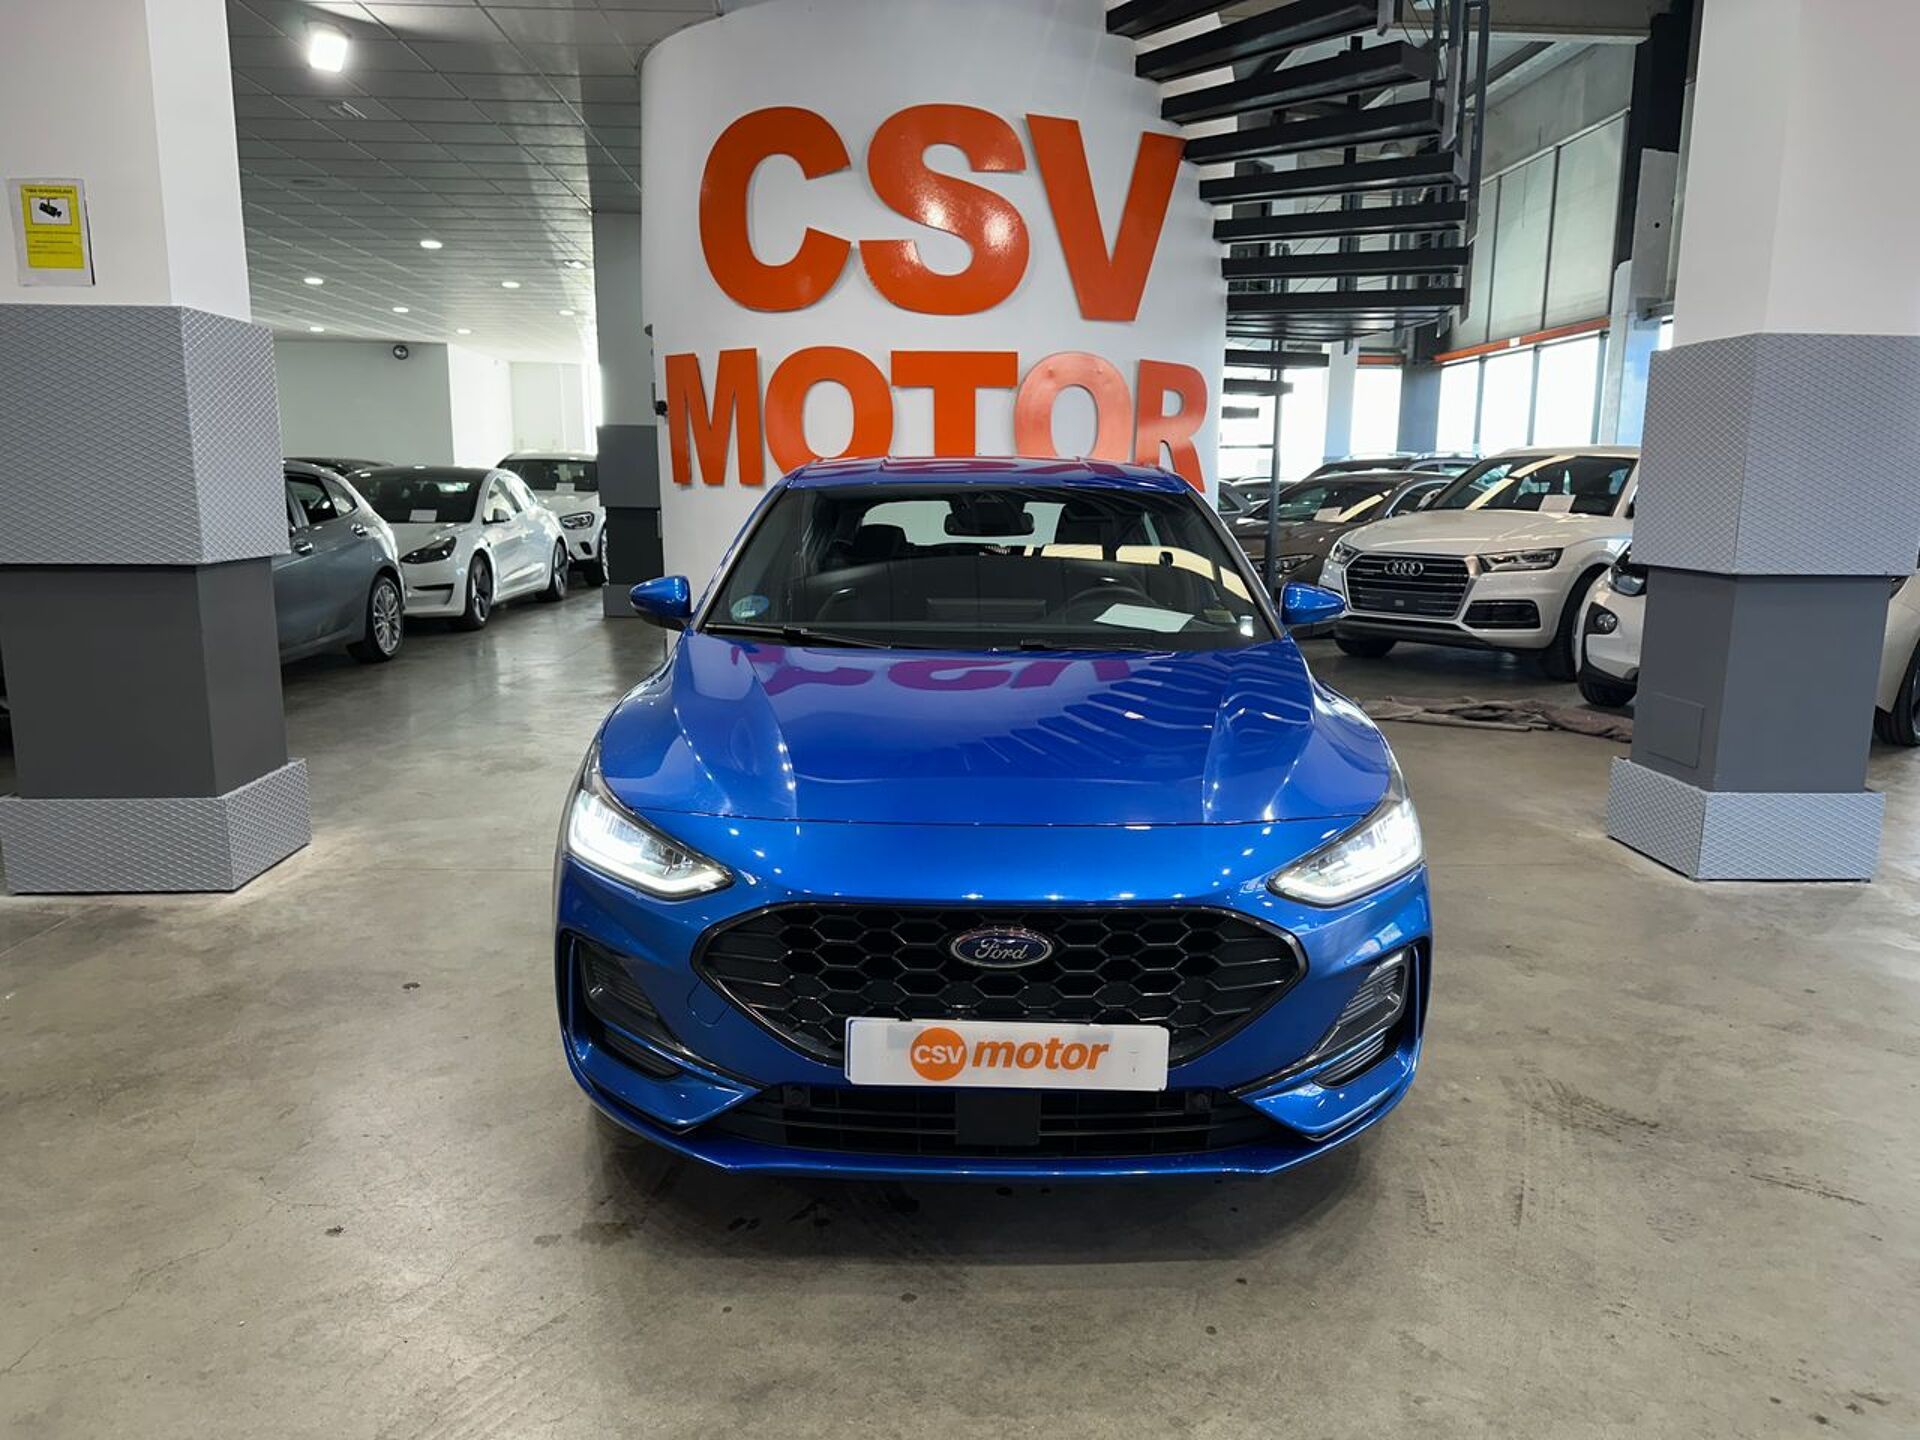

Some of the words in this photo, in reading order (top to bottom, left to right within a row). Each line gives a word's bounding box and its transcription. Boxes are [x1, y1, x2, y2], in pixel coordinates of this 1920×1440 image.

[699, 103, 1187, 322] CSV
[664, 345, 1209, 493] MOTOR
[974, 938, 1029, 960] Ford
[972, 1038, 1109, 1070] motor
